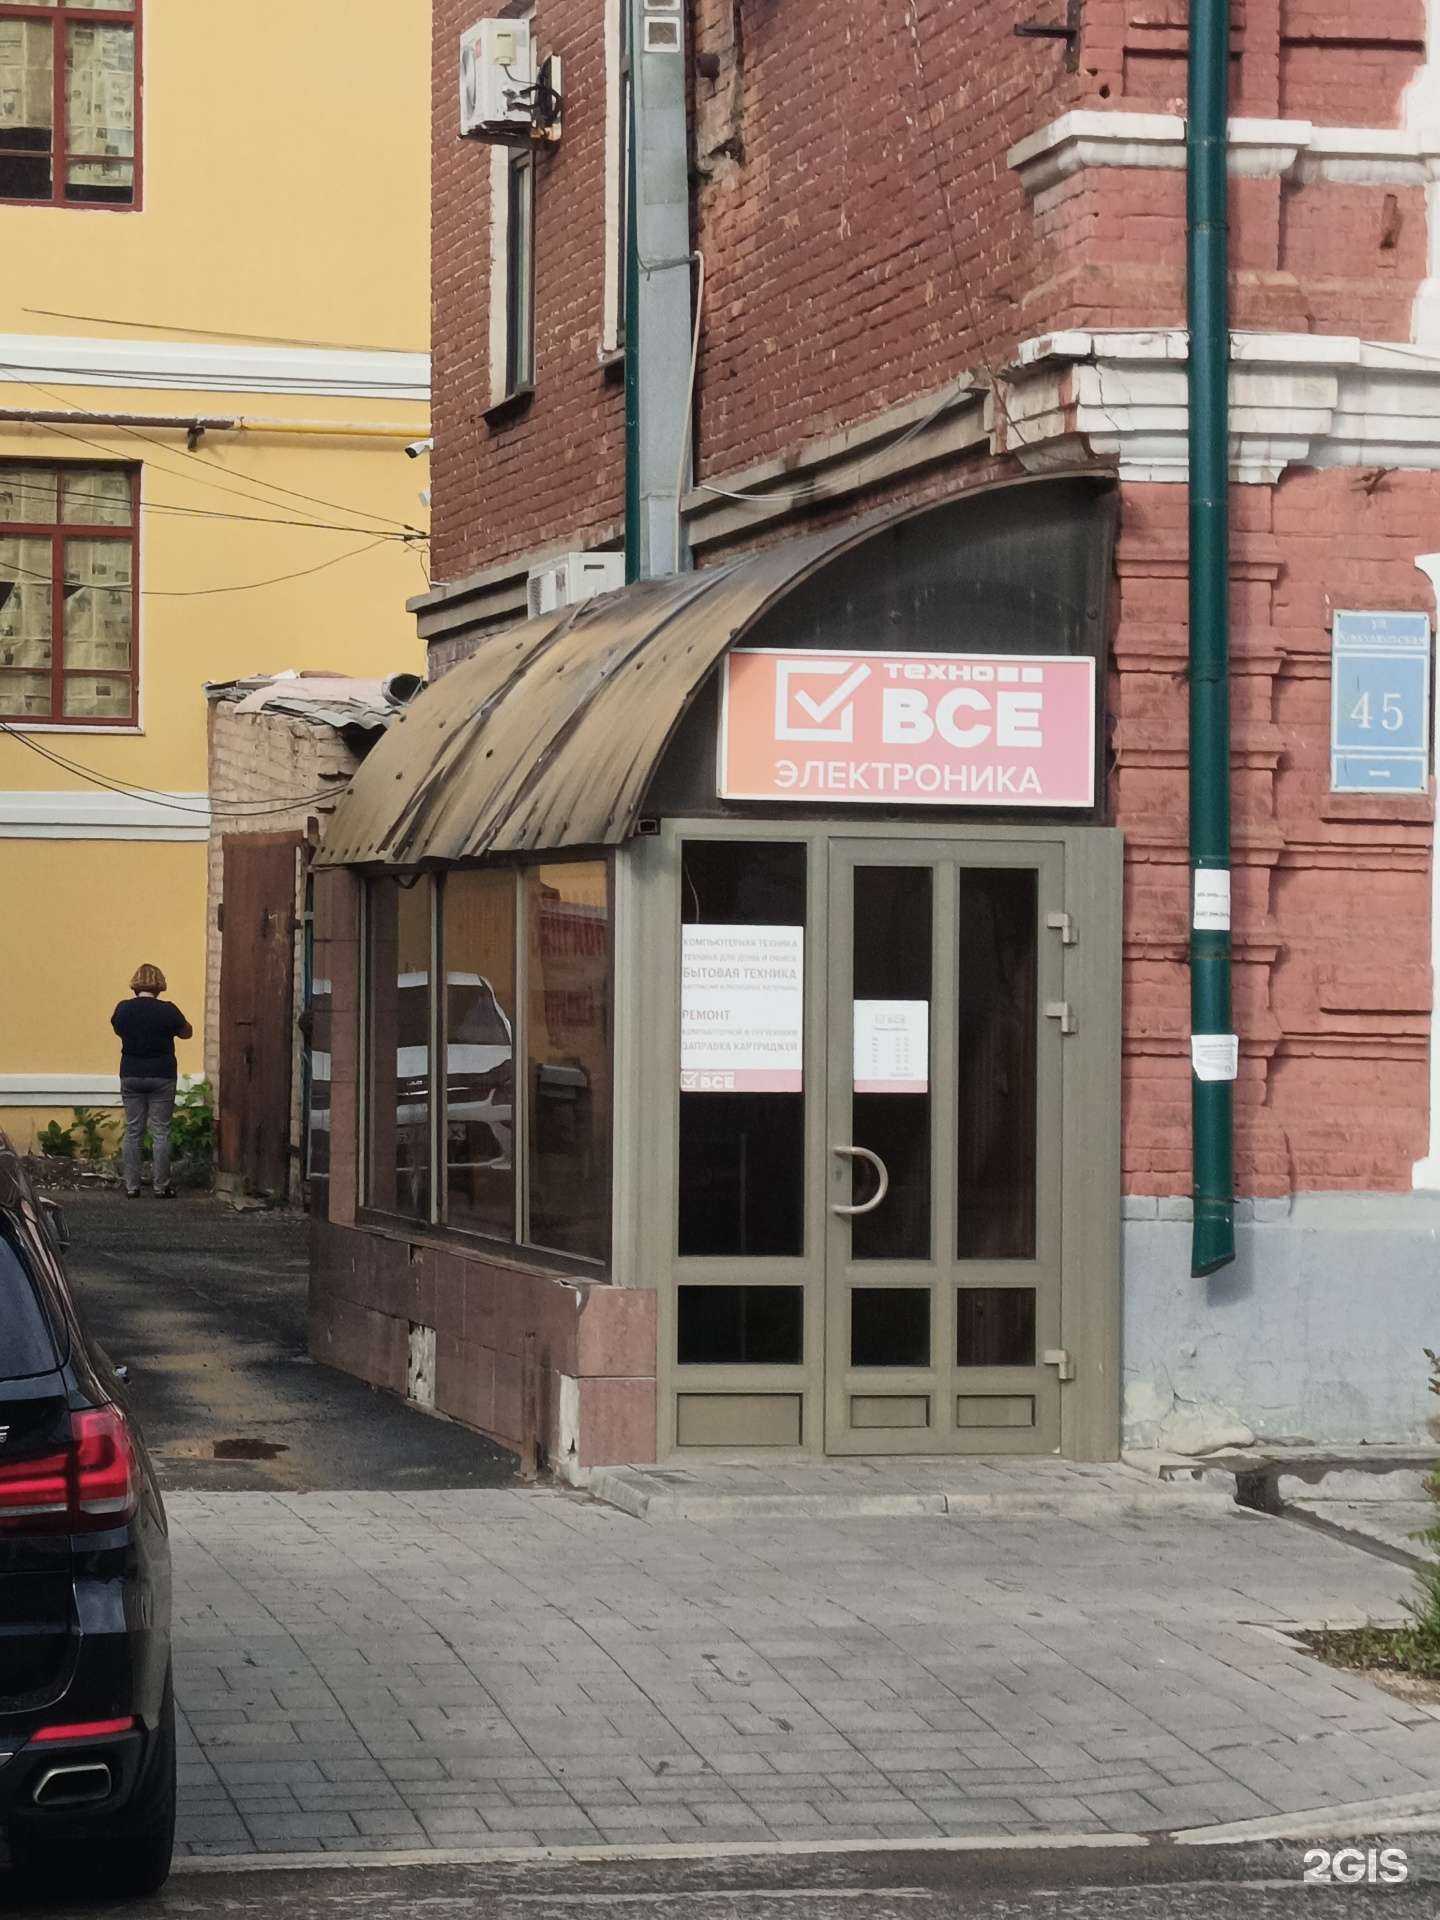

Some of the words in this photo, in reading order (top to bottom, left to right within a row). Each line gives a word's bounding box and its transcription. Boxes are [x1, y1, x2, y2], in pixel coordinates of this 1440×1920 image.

[882, 687, 1043, 748] ВСЕ
[1350, 691, 1404, 731] 45
[774, 759, 1043, 794] ЭЛЕКТРОНИКА
[683, 967, 740, 979] БЫТОВАЯ
[743, 968, 797, 980] ТЕХНИКА
[682, 1009, 731, 1021] РЕМОНТ
